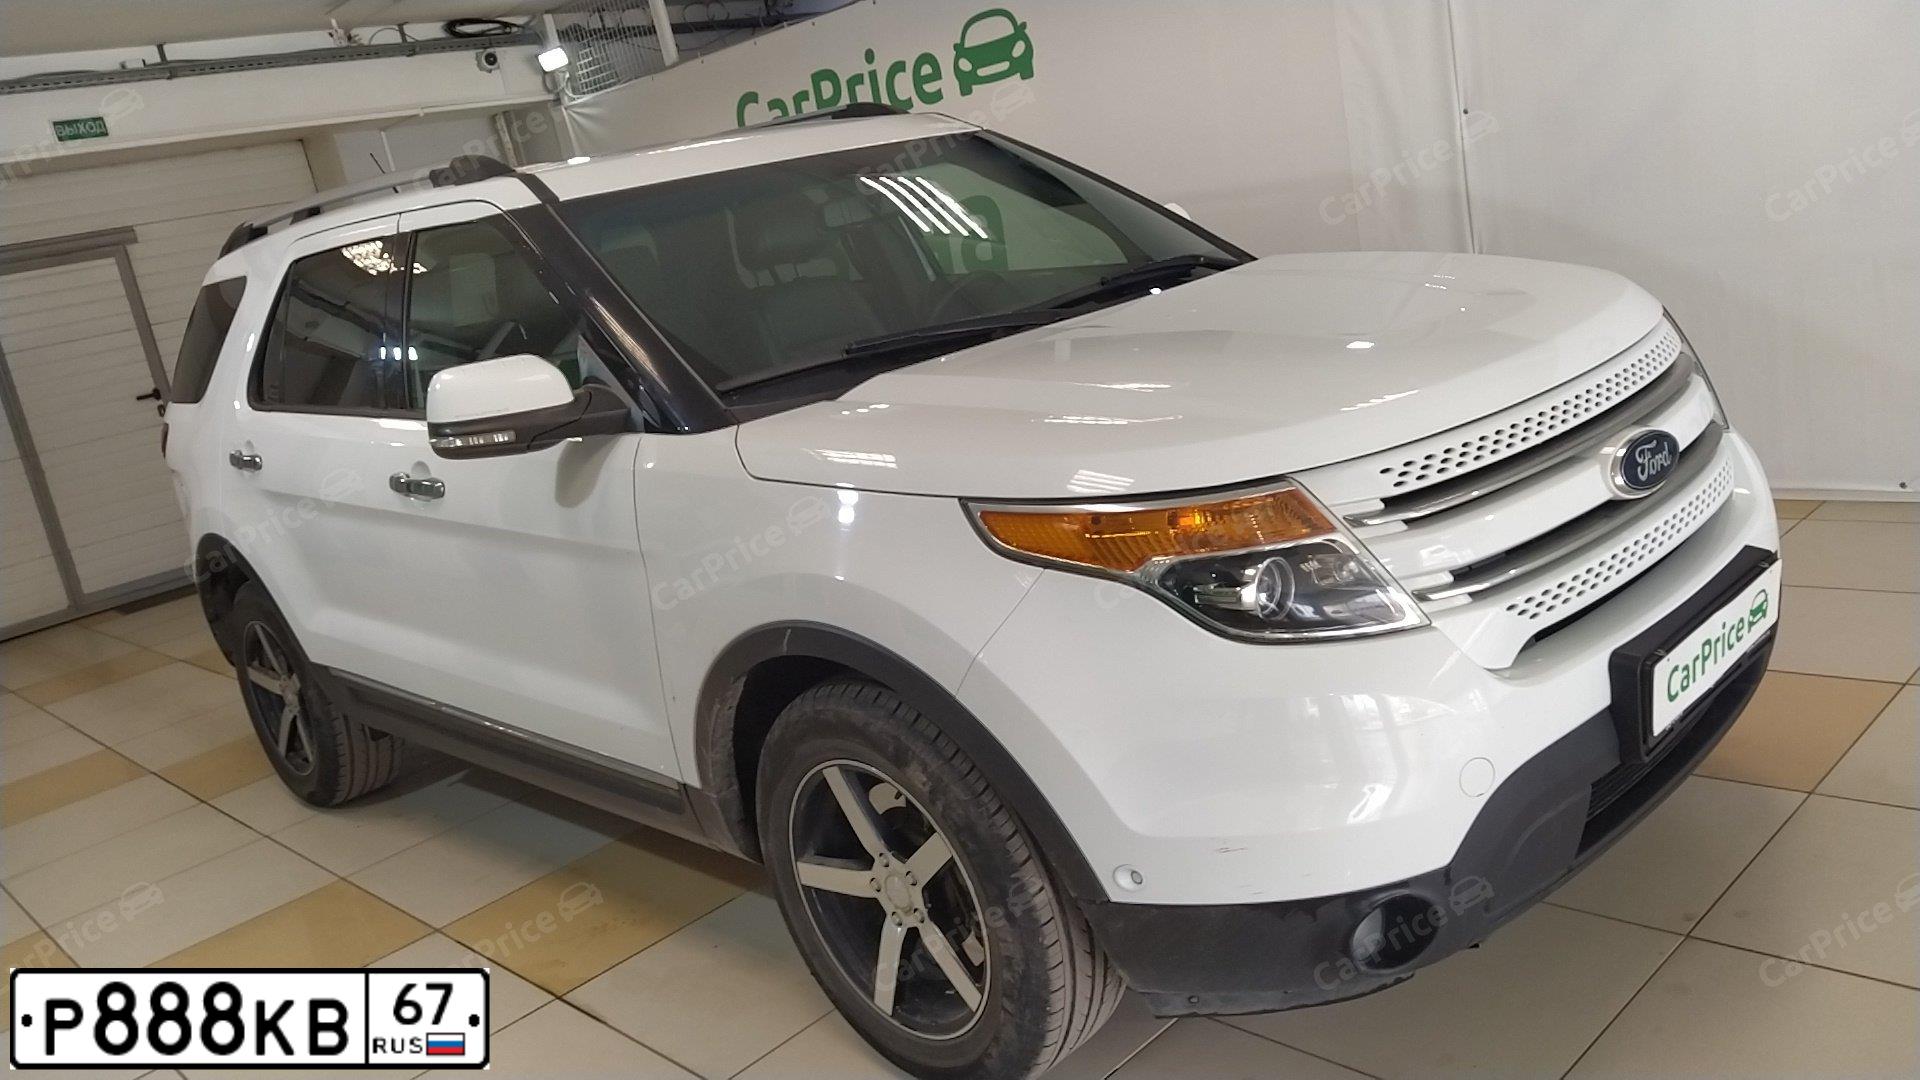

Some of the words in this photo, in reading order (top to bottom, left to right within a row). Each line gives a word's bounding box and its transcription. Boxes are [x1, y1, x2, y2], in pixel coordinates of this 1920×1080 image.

[55, 120, 107, 137] ВЫХОД
[1635, 439, 1671, 481] Ford
[1667, 616, 1745, 703] CarPrice
